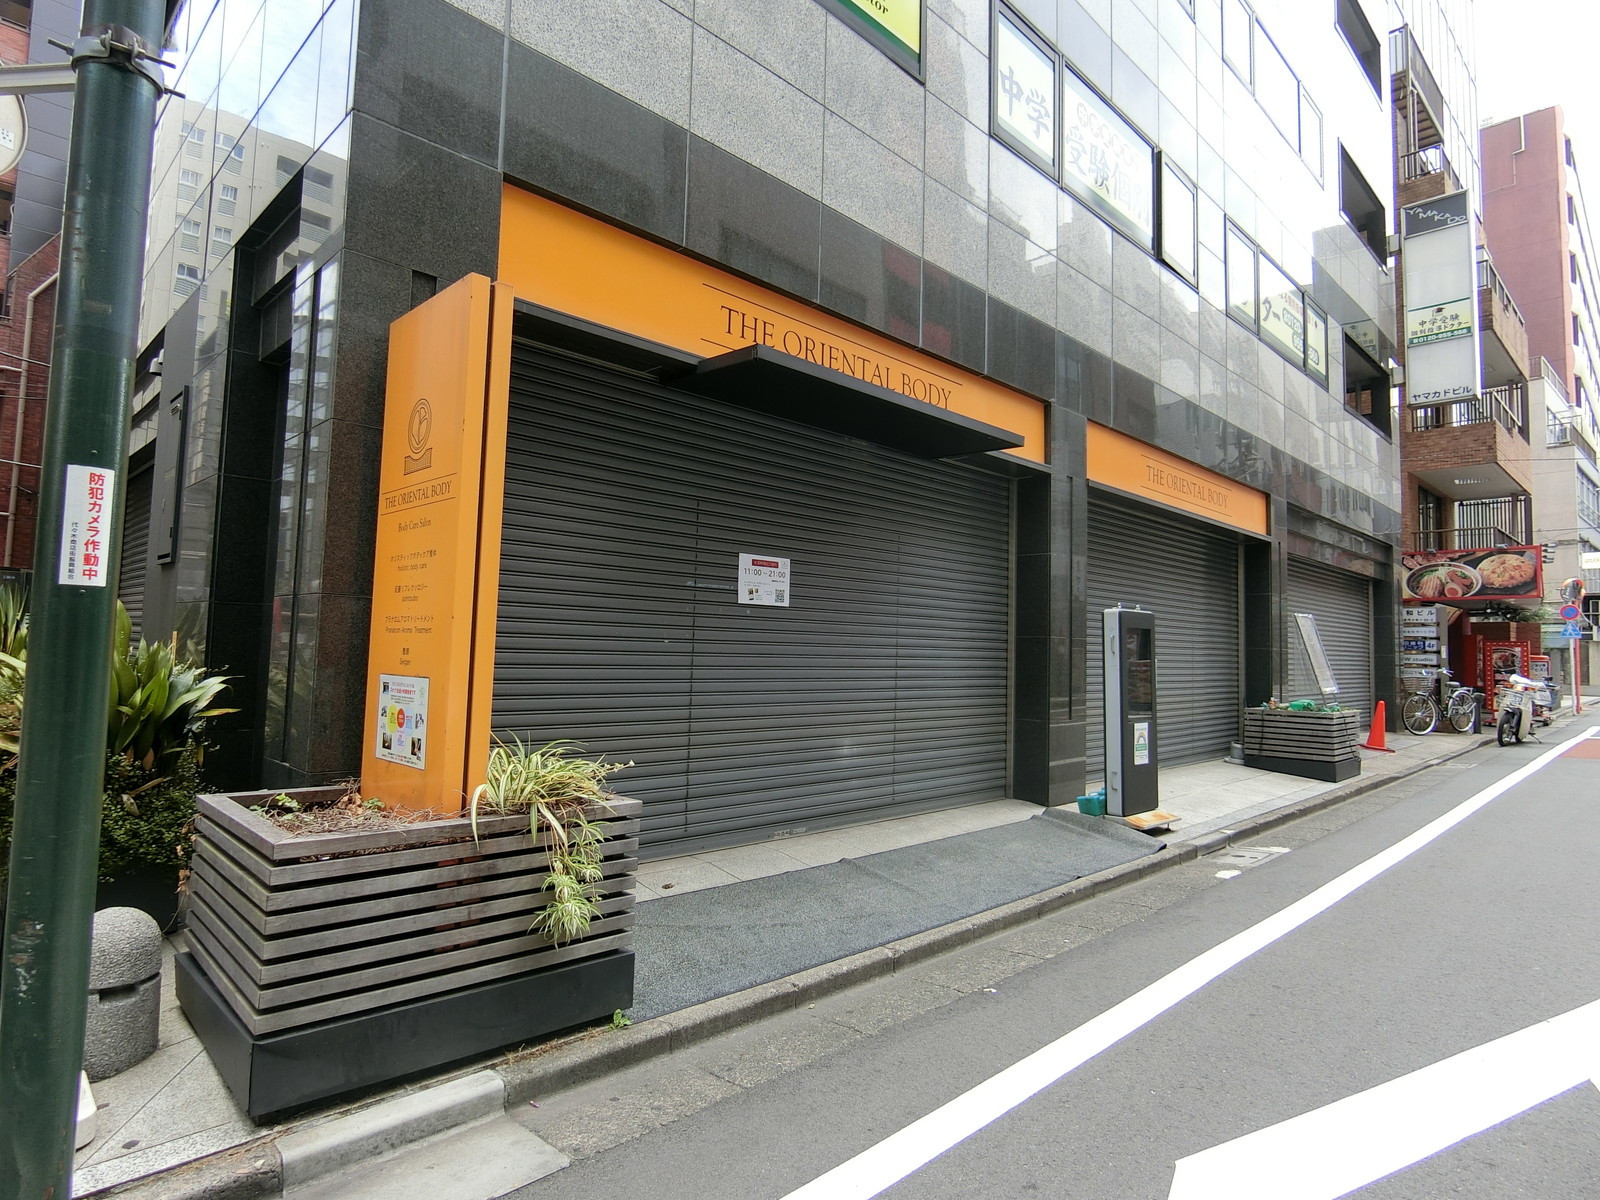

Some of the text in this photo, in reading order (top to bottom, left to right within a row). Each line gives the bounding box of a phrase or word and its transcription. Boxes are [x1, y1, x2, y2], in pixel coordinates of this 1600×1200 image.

[999, 65, 1050, 140] 中学
[1411, 321, 1470, 337] 個別指導ドクター
[1418, 313, 1460, 328] 中学受験
[720, 305, 951, 410] THE ORIENTAL BODY
[1412, 386, 1473, 401] ヤマカドビル
[385, 480, 452, 509] THE ORIENTAL BODY
[1146, 465, 1228, 508] THE ORIENTAL BODY
[82, 472, 106, 580] 防犯カメラ作動中
[398, 517, 432, 533] Body Care Salon
